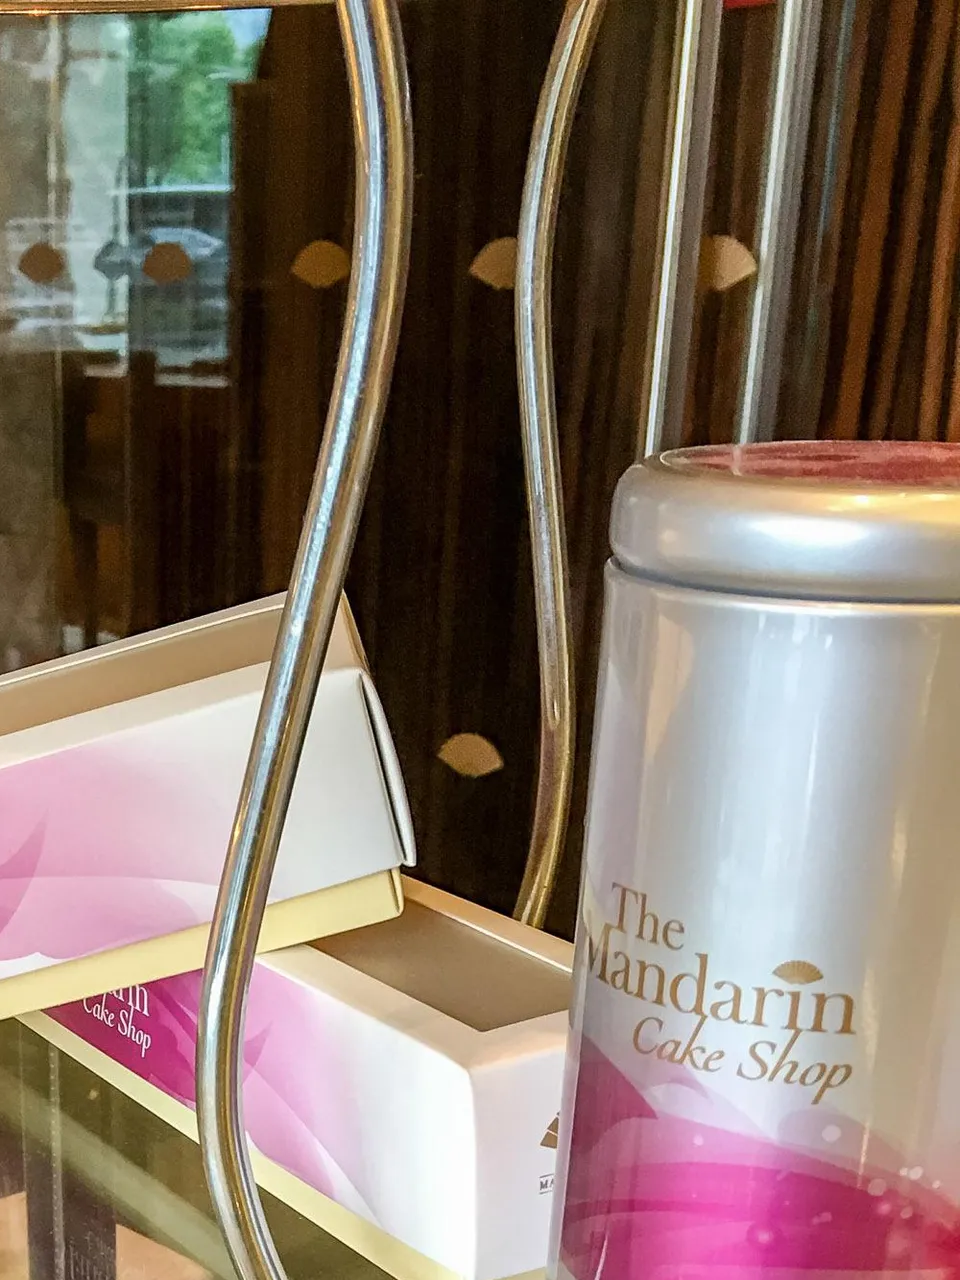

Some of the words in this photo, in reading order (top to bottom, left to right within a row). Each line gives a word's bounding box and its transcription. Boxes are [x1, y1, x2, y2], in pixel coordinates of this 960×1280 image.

[612, 882, 685, 951] The
[587, 921, 857, 1036] Mandarin
[83, 993, 115, 1028] Cake
[117, 1005, 152, 1058] Shop
[632, 1013, 726, 1073] Cake
[737, 1027, 854, 1106] Shop
